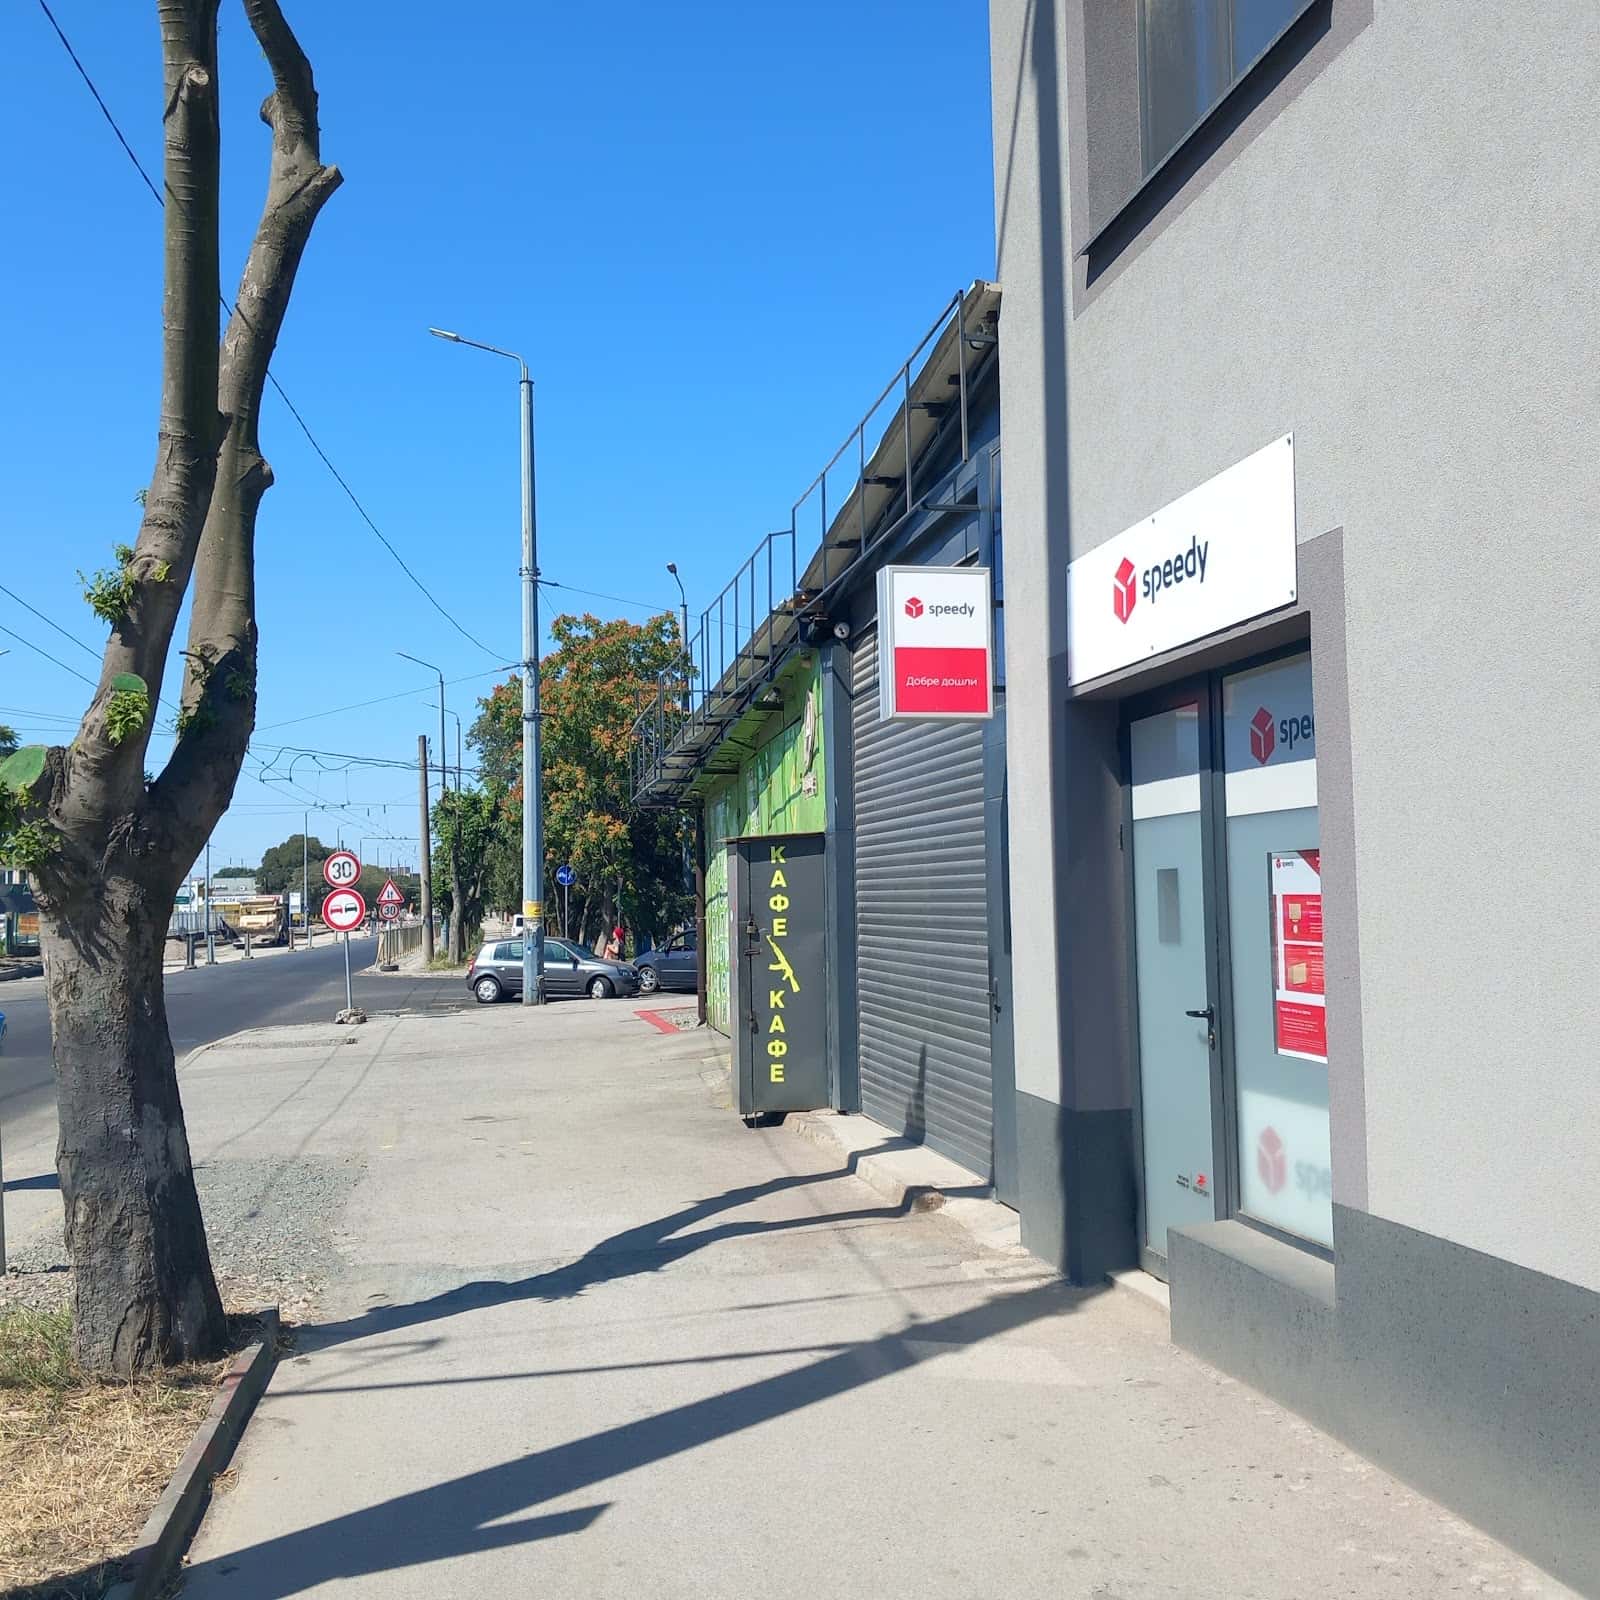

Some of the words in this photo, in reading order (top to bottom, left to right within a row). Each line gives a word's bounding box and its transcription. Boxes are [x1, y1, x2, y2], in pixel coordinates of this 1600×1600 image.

[1142, 535, 1209, 604] speedy
[928, 602, 975, 618] speedy
[905, 676, 940, 687] Добре
[941, 678, 978, 687] дошли
[332, 860, 352, 880] 30
[769, 846, 789, 937] КАФЕ
[384, 905, 396, 915] 30
[767, 990, 788, 1083] КАФЕ
